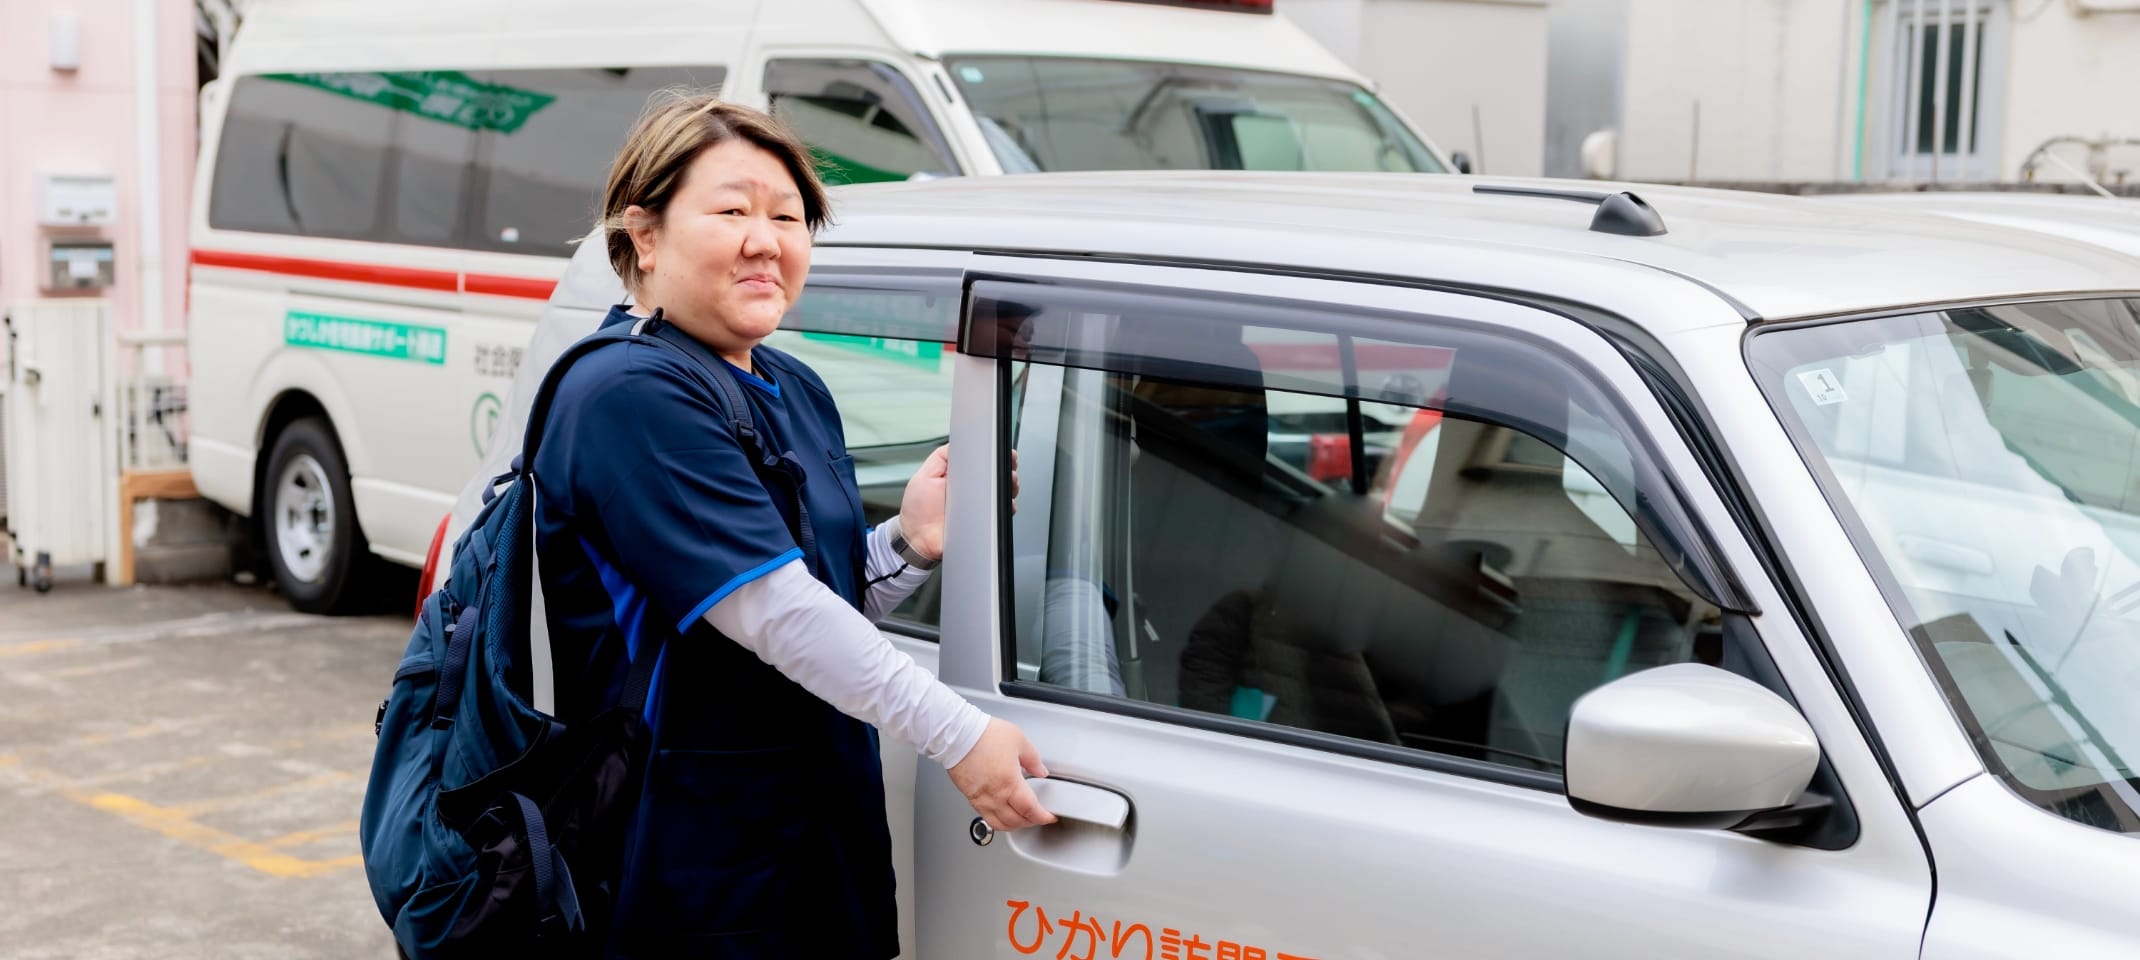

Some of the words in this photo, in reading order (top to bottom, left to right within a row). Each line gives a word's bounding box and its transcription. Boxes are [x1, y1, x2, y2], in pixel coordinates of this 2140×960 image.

[1816, 373, 1835, 392] 1
[1007, 900, 1322, 960] ひかり訪
